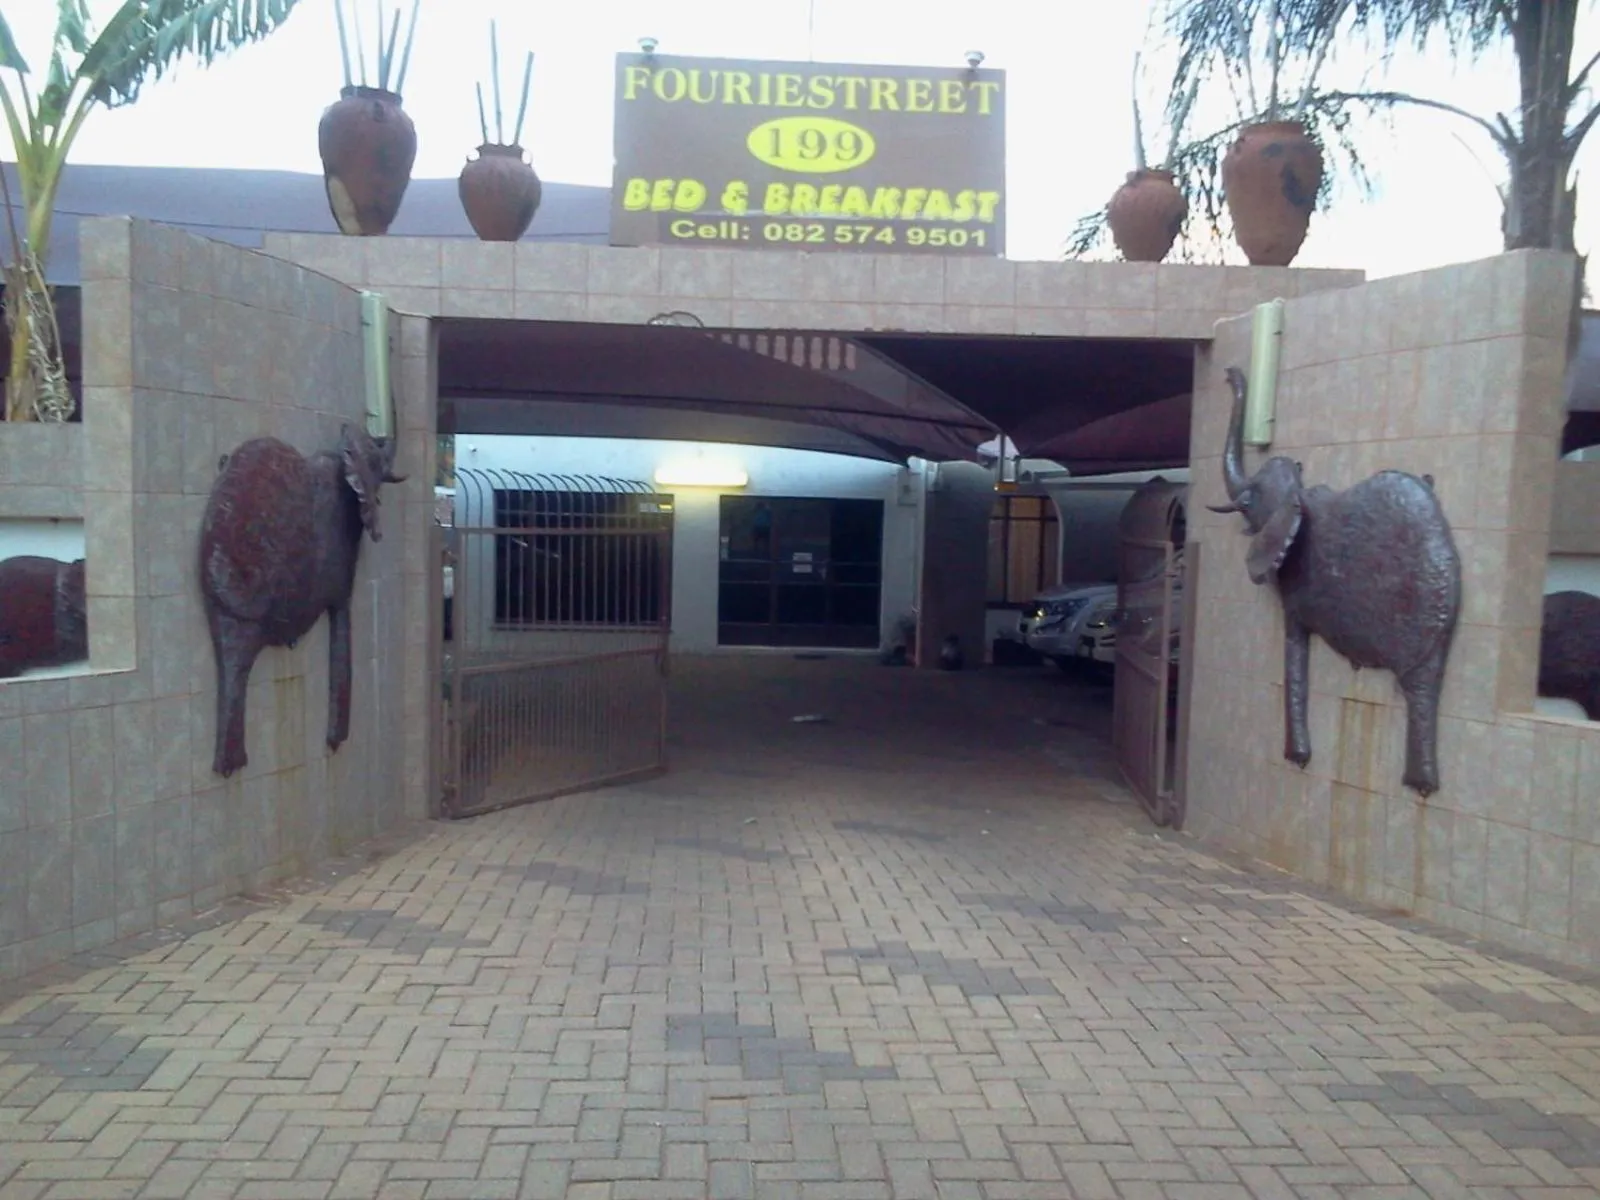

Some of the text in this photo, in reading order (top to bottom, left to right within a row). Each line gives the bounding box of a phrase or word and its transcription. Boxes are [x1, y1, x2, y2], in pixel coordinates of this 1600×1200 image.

[624, 67, 999, 114] FOURIESTREET
[767, 127, 864, 162] 199
[623, 178, 999, 223] BED & BREAKFAST
[670, 219, 987, 247] Cell: 082 574 9501
